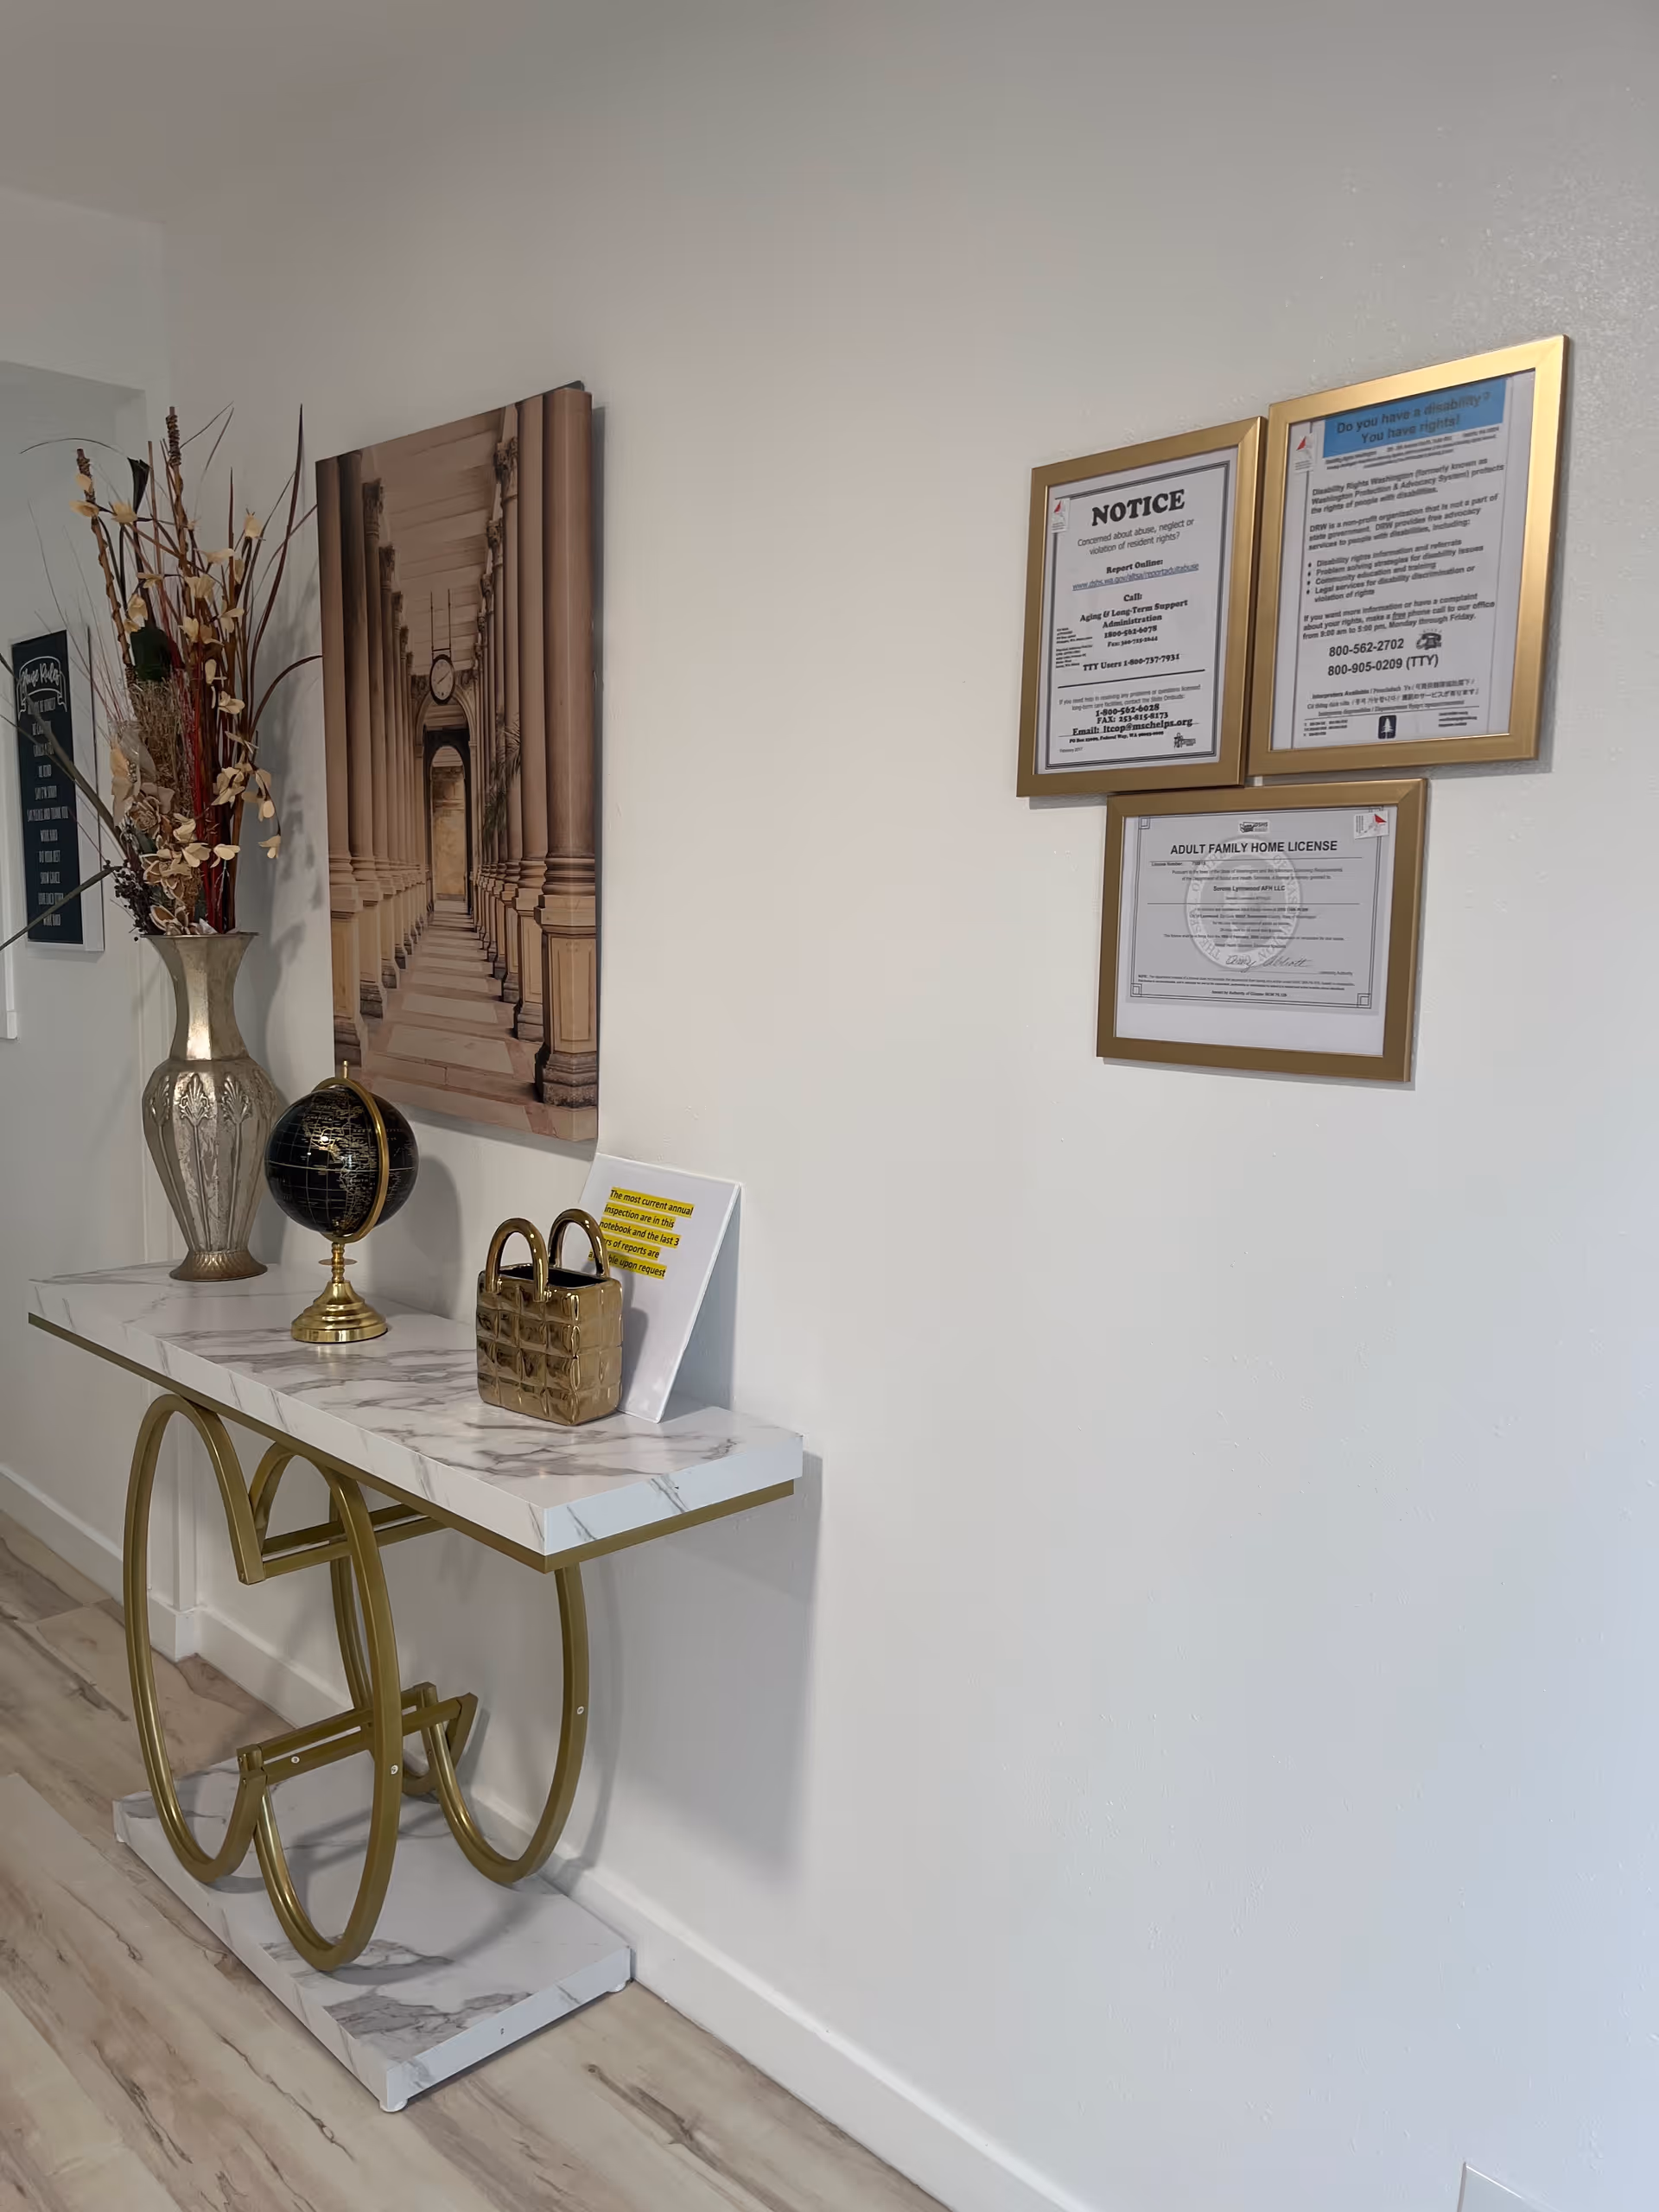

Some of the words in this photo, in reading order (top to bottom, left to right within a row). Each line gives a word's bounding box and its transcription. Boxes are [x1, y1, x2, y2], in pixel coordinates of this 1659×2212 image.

[1338, 422, 1353, 433] Do
[1357, 417, 1377, 432] you
[1382, 410, 1409, 423] have
[1424, 391, 1491, 416] disability?
[1362, 433, 1383, 443] You
[1389, 425, 1416, 439] have
[1420, 415, 1460, 432] rights!
[1092, 489, 1185, 526] NOTICE
[1310, 524, 1327, 532] DRW
[1343, 516, 1376, 526] non-profit
[1471, 496, 1487, 506] part
[1376, 522, 1393, 531] DRW
[1395, 518, 1426, 529] provides
[1445, 508, 1481, 518] advocacy
[1077, 534, 1111, 546] Concerned
[1113, 529, 1132, 539] about
[1135, 525, 1156, 536] abuse,
[1159, 520, 1185, 531] neglect
[1090, 543, 1116, 555] violation
[1118, 541, 1126, 550] of
[1127, 537, 1154, 548] resident
[1156, 531, 1179, 543] rights?
[1309, 542, 1337, 550] services
[1348, 536, 1371, 546] people
[1317, 557, 1349, 567] Disability
[1430, 539, 1462, 549] referrals
[1107, 563, 1133, 574] Report
[1135, 559, 1163, 569] Online:
[1316, 567, 1344, 575] Problem
[1374, 557, 1408, 567] strategies
[1315, 575, 1356, 584] Community
[1357, 569, 1391, 578] education
[1336, 582, 1364, 591] services
[1377, 575, 1410, 584] disability
[1411, 568, 1464, 580] discrimination
[1124, 593, 1142, 601] Call:
[1314, 594, 1344, 602] violation
[1355, 589, 1374, 598] rights
[1363, 603, 1402, 613] information
[1440, 593, 1478, 603] complaint
[1080, 613, 1102, 622] Aging
[1111, 605, 1153, 618] Long-Term
[1154, 600, 1188, 610] Support
[1393, 612, 1406, 620] free
[1103, 614, 1162, 629] Administration
[1104, 626, 1157, 639] 1800-562-6078
[1329, 639, 1404, 657] 800-562-2702
[1083, 663, 1098, 671] TTY
[1101, 660, 1122, 670] Users
[1123, 653, 1180, 667] 1-800-737-7931
[1328, 658, 1402, 676] 800-905-0209
[1407, 654, 1439, 670] (TTY)
[40, 662, 60, 686] Rules
[1096, 703, 1160, 716] 1-800-562-6028
[1118, 712, 1168, 722] 253-815-8173
[1072, 727, 1099, 735] Email:
[1103, 719, 1192, 733] ltcop@mschelps.org
[1171, 843, 1205, 855] ADULT
[1209, 842, 1248, 854] FAMILY
[1251, 842, 1284, 853] HOME
[1288, 841, 1338, 852] LICENSE
[610, 1189, 622, 1200] The
[624, 1193, 641, 1205] most
[642, 1198, 667, 1211] current
[668, 1205, 694, 1217] annual
[604, 1205, 639, 1220] inspection
[640, 1214, 652, 1223] are
[652, 1216, 660, 1224] in
[662, 1217, 674, 1229] this
[600, 1221, 631, 1236] notebook
[632, 1225, 646, 1238] and
[647, 1230, 659, 1242] the
[660, 1234, 674, 1245] last
[674, 1236, 679, 1246] 3
[621, 1243, 646, 1256] reports
[647, 1249, 659, 1258] are
[620, 1258, 638, 1270] upon
[639, 1264, 666, 1278] request
